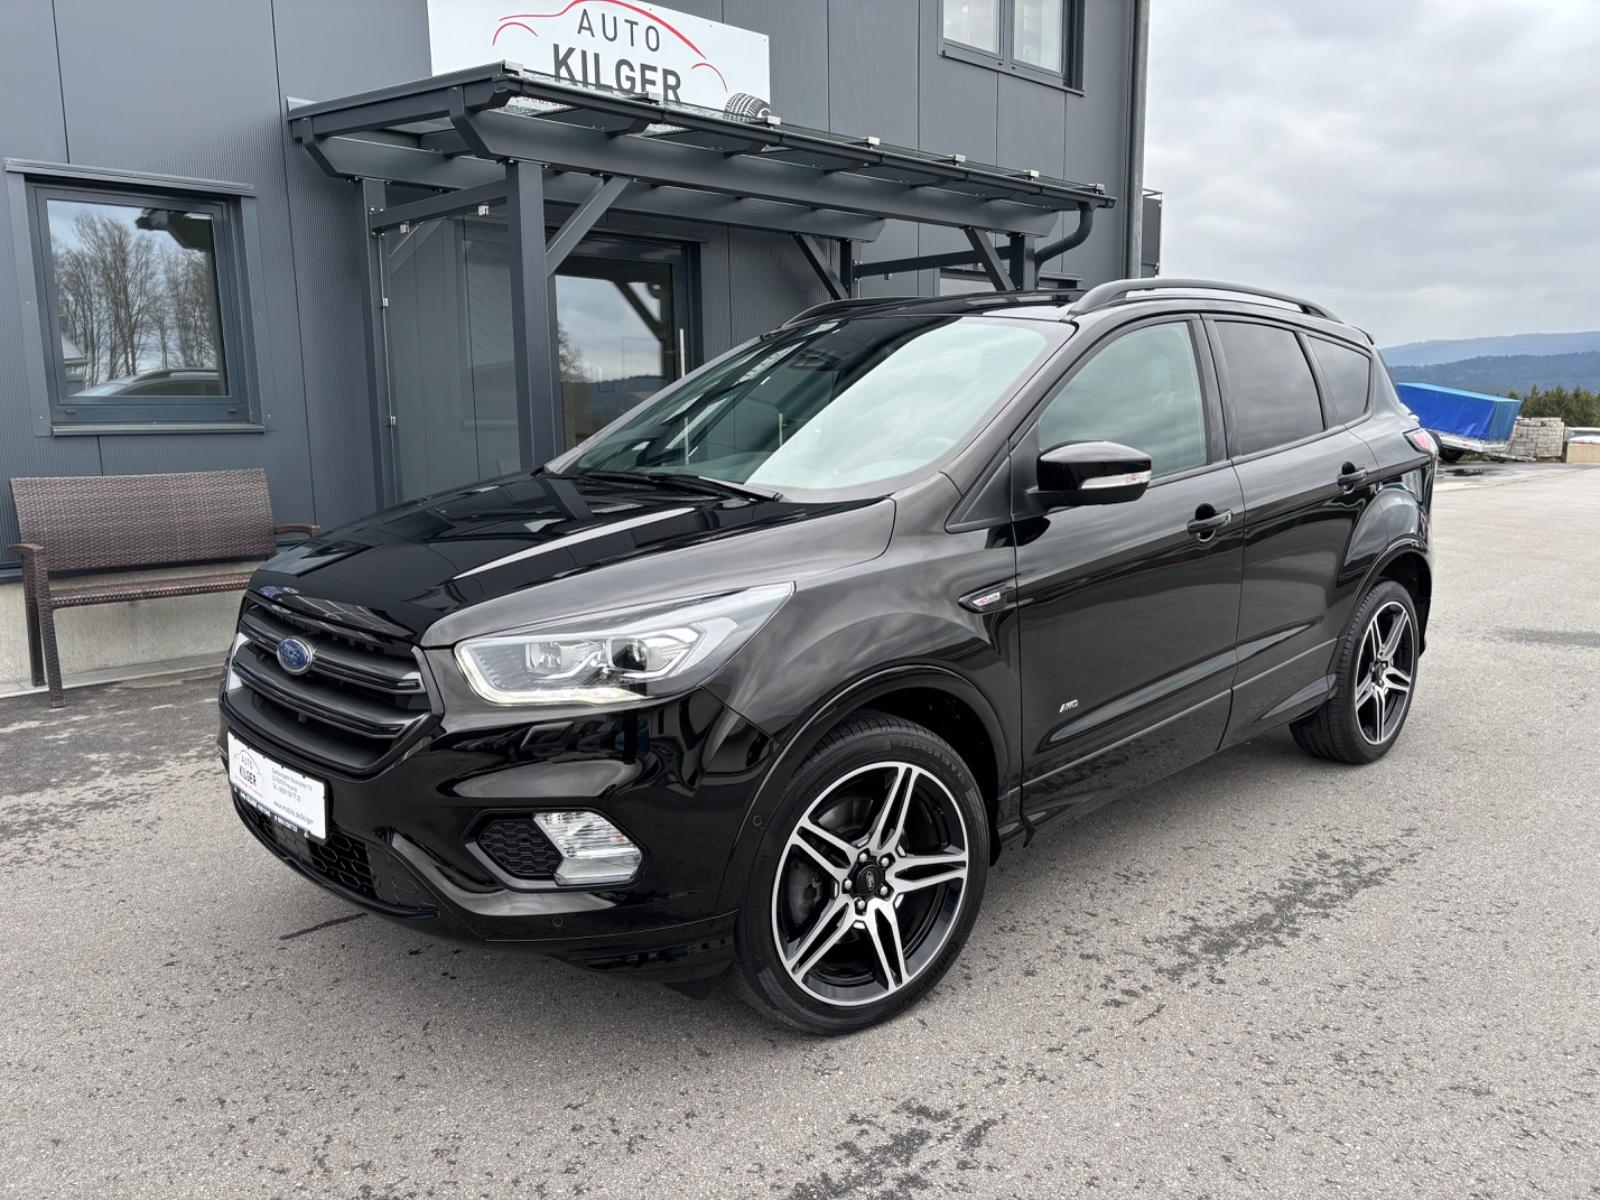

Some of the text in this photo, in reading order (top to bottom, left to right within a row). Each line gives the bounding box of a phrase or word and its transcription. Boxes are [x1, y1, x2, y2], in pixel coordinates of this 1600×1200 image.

[577, 8, 660, 53] AUTO
[553, 43, 682, 102] KILGER
[239, 765, 257, 785] KILGER
[241, 755, 253, 770] AUTO
